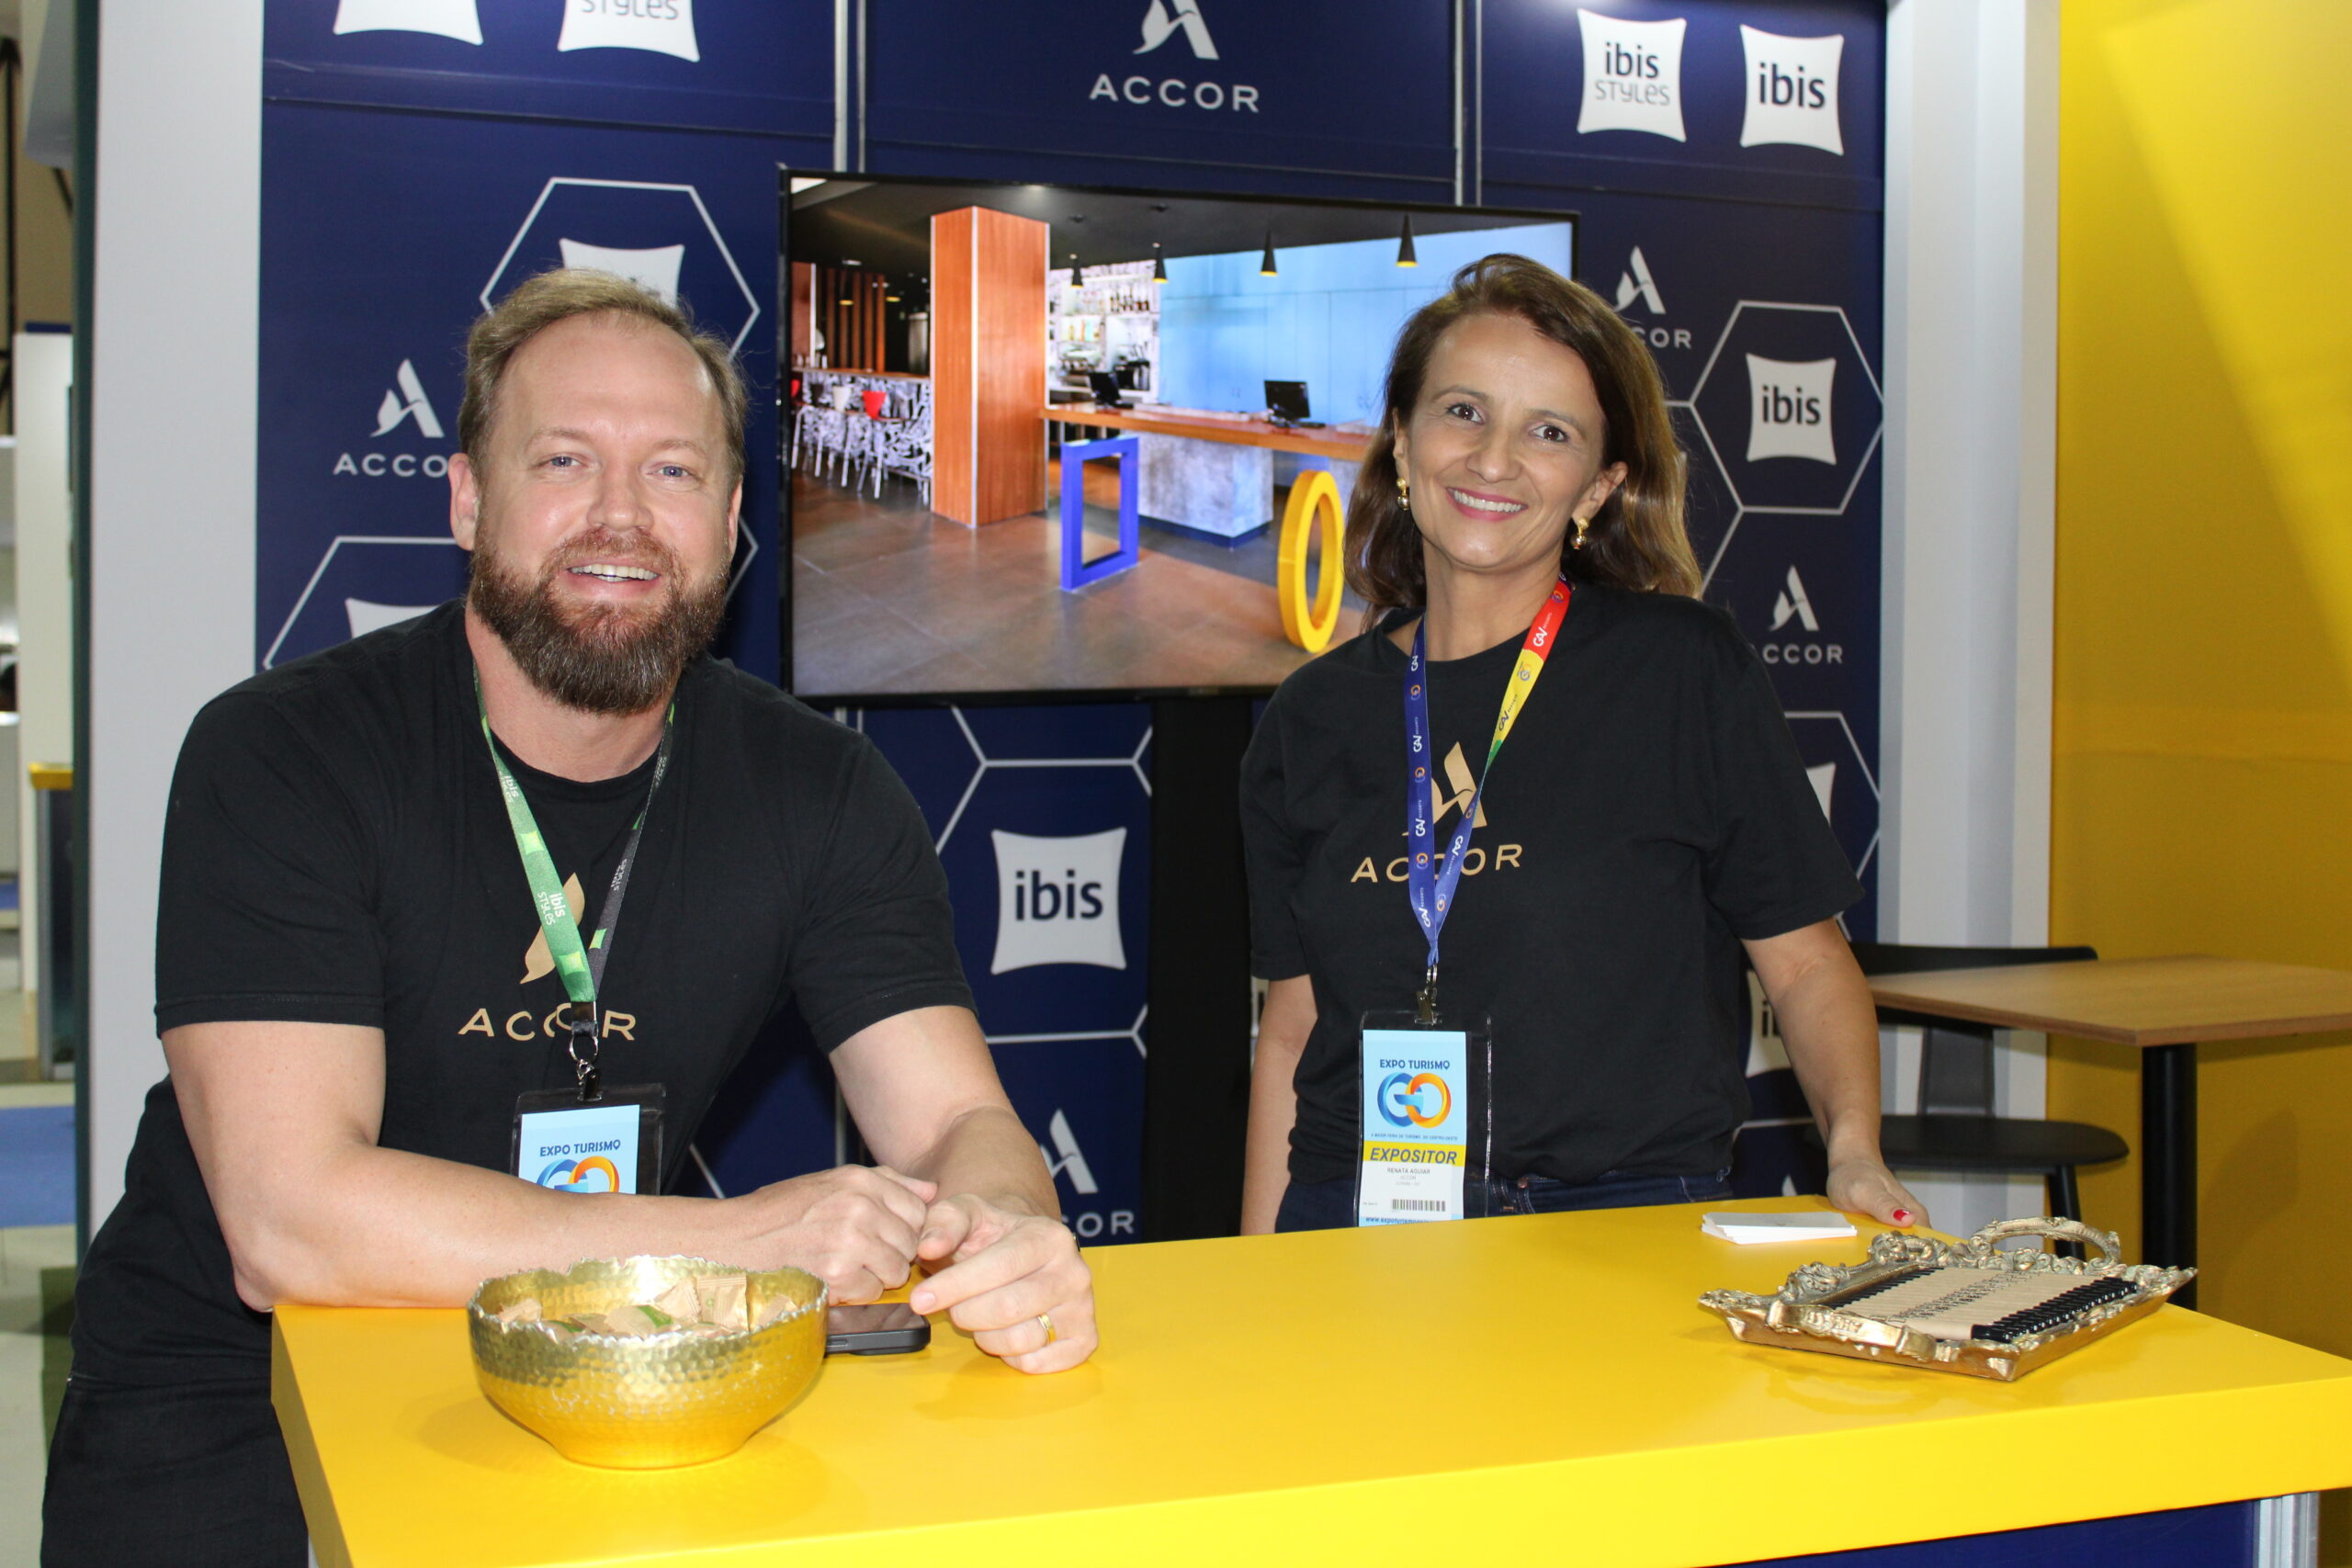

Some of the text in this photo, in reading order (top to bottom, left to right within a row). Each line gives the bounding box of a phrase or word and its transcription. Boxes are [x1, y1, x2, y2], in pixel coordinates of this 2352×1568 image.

[1605, 41, 1659, 79] ibis
[1089, 73, 1259, 113] ACCOR
[1758, 62, 1826, 108] ibis
[1762, 385, 1821, 425] ibis
[333, 452, 448, 478] ACCO
[1761, 644, 1843, 664] CCOR
[548, 892, 566, 918] ibis
[1014, 868, 1103, 921] ibis
[1379, 1059, 1451, 1071] EXPO TURISMO
[539, 1139, 621, 1157] EXPO TURISMO
[1370, 1147, 1457, 1165] EXPOSITOR
